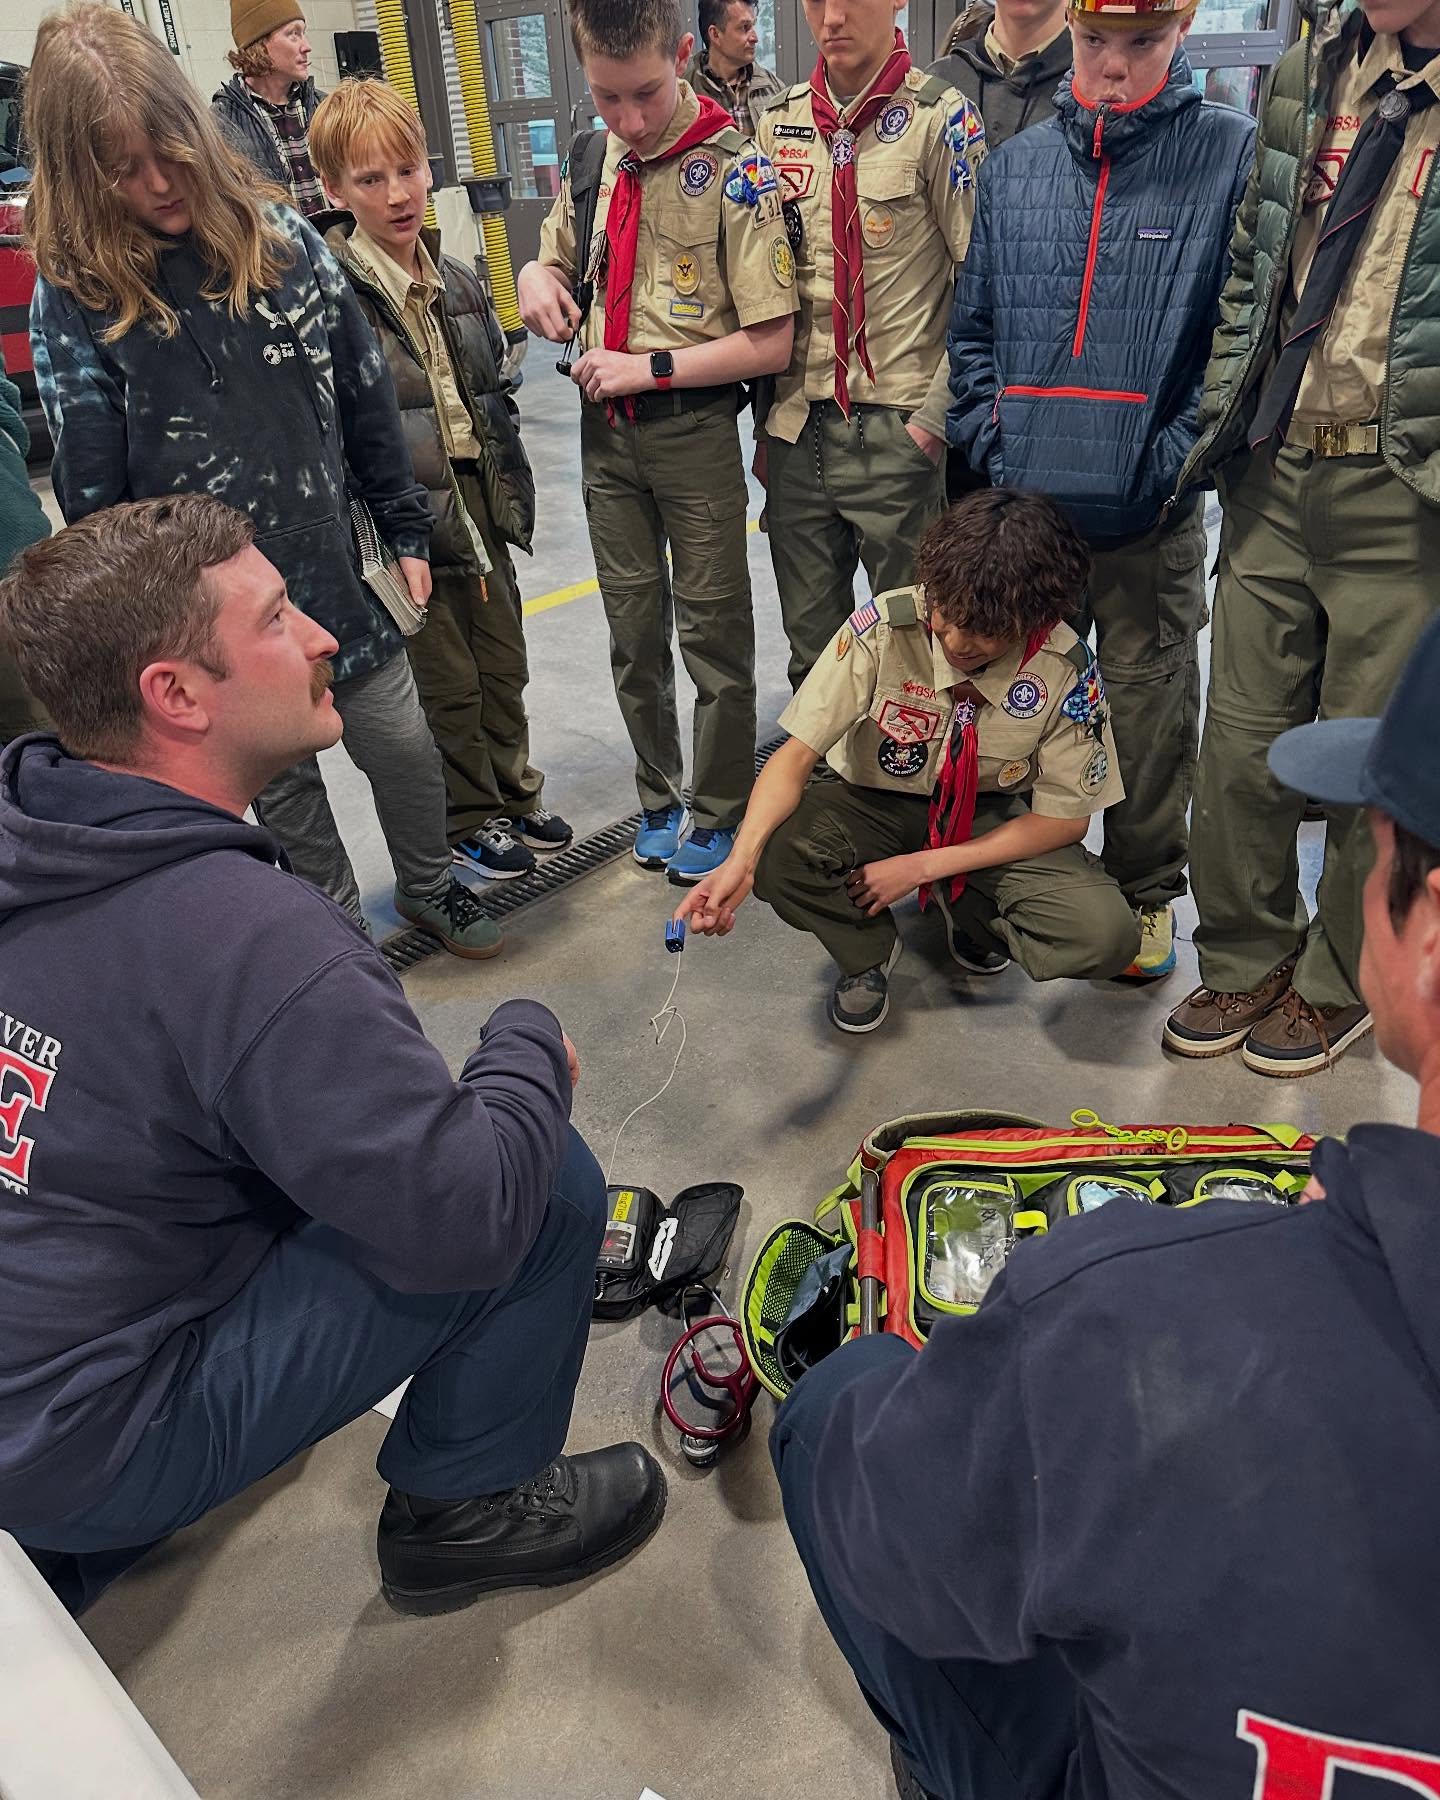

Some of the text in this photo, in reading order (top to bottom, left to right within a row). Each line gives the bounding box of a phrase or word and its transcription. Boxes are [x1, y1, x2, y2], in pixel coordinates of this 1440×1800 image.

[161, 2, 178, 48] SNOW MELT
[1333, 115, 1361, 131] BSA
[789, 148, 808, 159] BSA
[915, 685, 938, 701] BSA
[0, 1011, 62, 1071] VER
